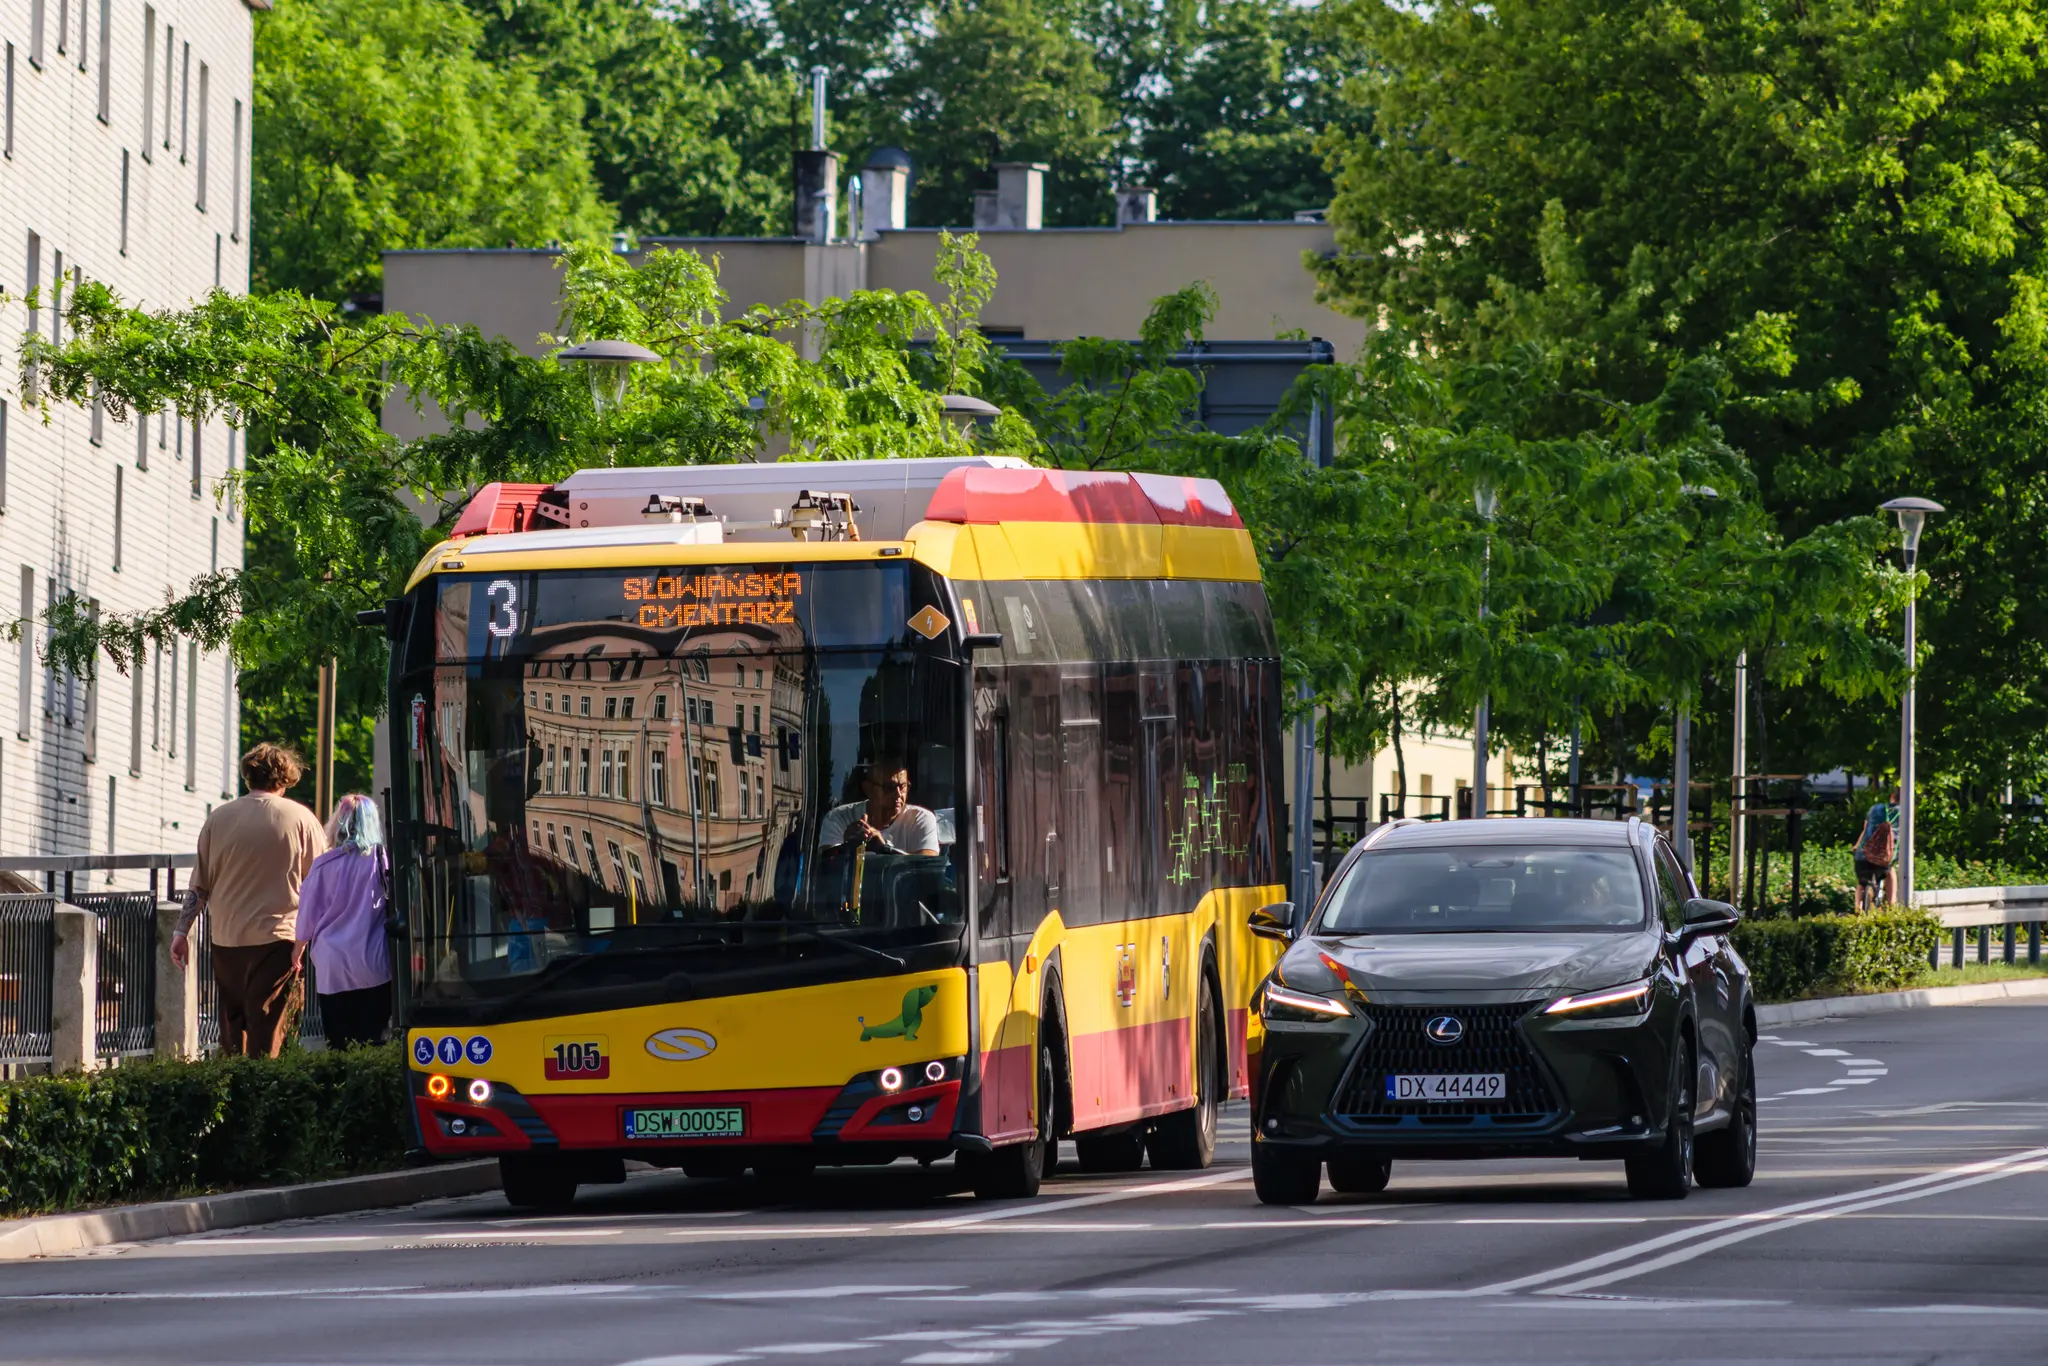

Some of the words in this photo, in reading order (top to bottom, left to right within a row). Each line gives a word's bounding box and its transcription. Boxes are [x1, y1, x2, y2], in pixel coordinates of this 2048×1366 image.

[624, 573, 801, 600] SŁOWIAŃSKA
[487, 579, 517, 637] 3
[639, 601, 795, 628] CMENTARZ
[552, 1042, 601, 1072] 105
[1399, 1077, 1426, 1097] DX
[1435, 1076, 1500, 1097] 44449
[635, 1112, 673, 1132] DSW
[679, 1111, 740, 1131] 0005F
